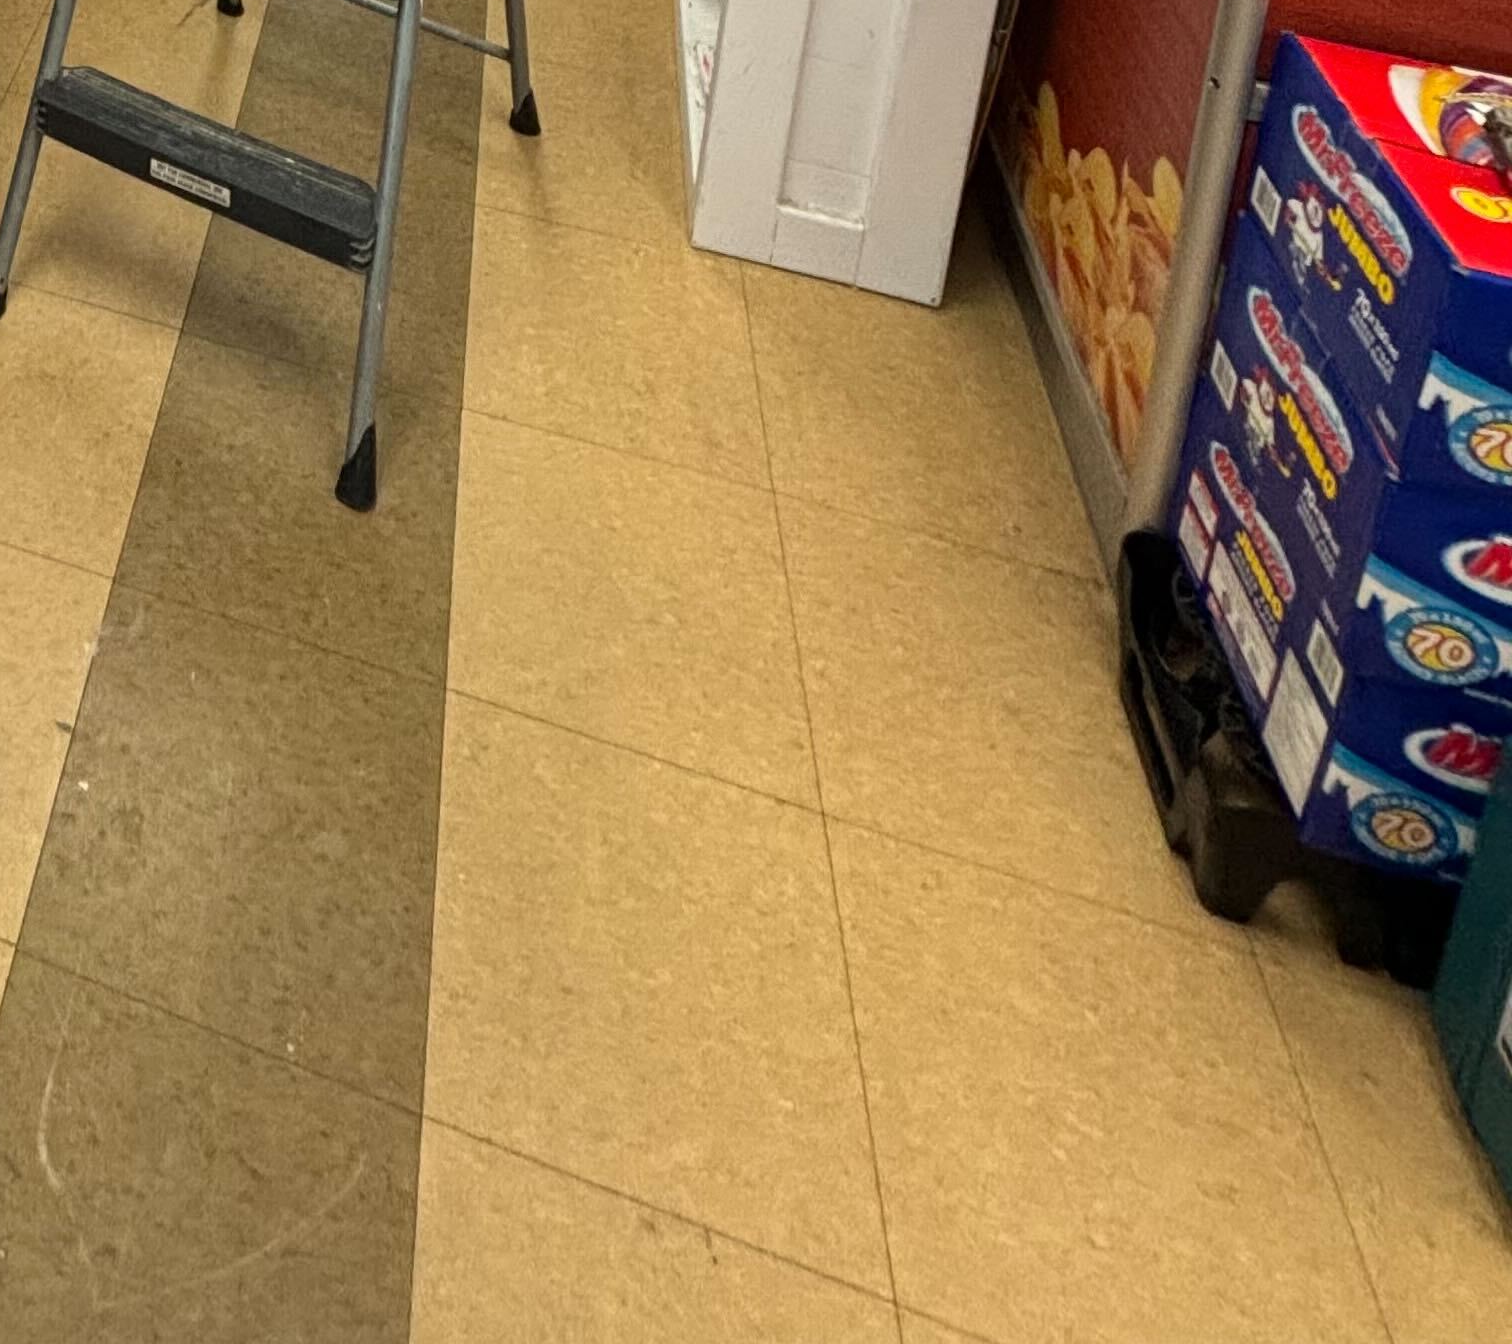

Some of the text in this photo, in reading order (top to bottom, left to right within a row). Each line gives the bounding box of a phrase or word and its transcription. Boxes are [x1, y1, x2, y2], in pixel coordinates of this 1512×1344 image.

[1328, 203, 1395, 305] JUMBO
[1278, 392, 1337, 500] JUMBO
[1234, 528, 1283, 623] JUMBO
[1407, 628, 1475, 672] 70
[1371, 814, 1436, 853] 70
